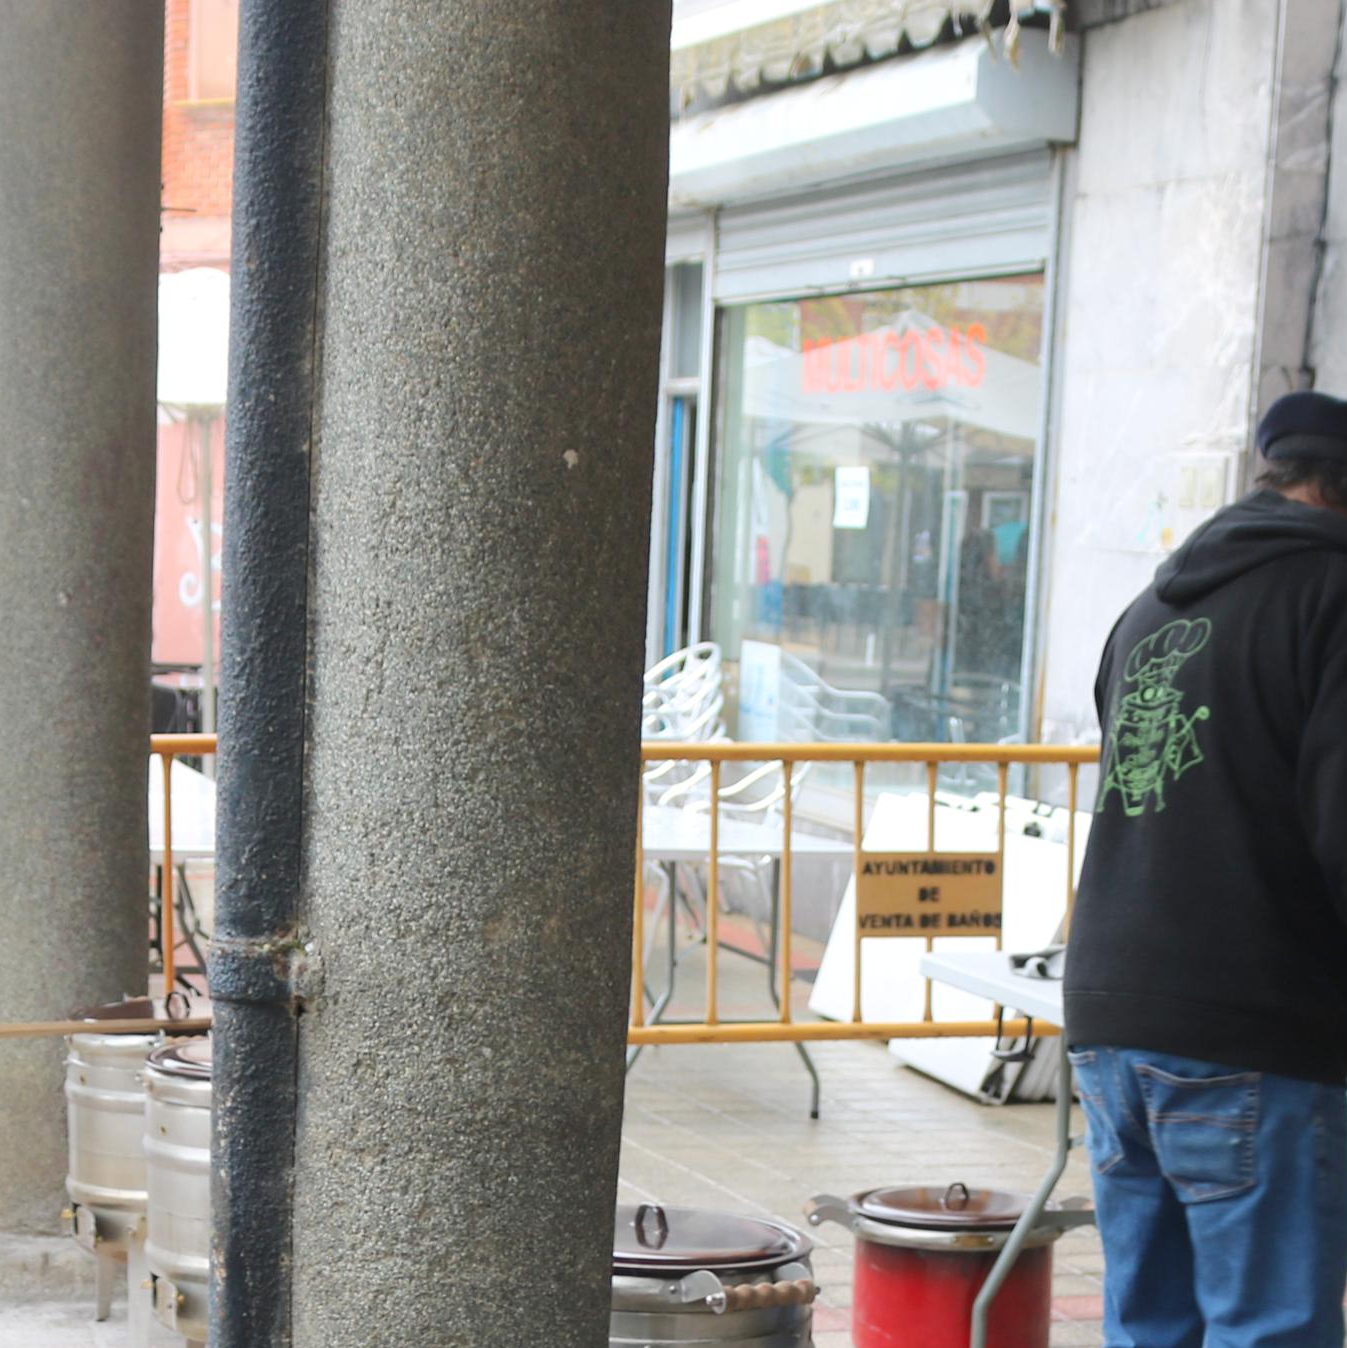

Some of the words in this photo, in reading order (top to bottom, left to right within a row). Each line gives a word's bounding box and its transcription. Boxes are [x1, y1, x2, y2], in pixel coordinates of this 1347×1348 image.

[802, 321, 987, 393] MULTICOSAS
[862, 859, 996, 876] AYUNTAMIENTO
[917, 887, 941, 903] DE
[858, 912, 913, 929] VENTA
[920, 912, 943, 929] DE
[948, 909, 1002, 929] BAÑOS
